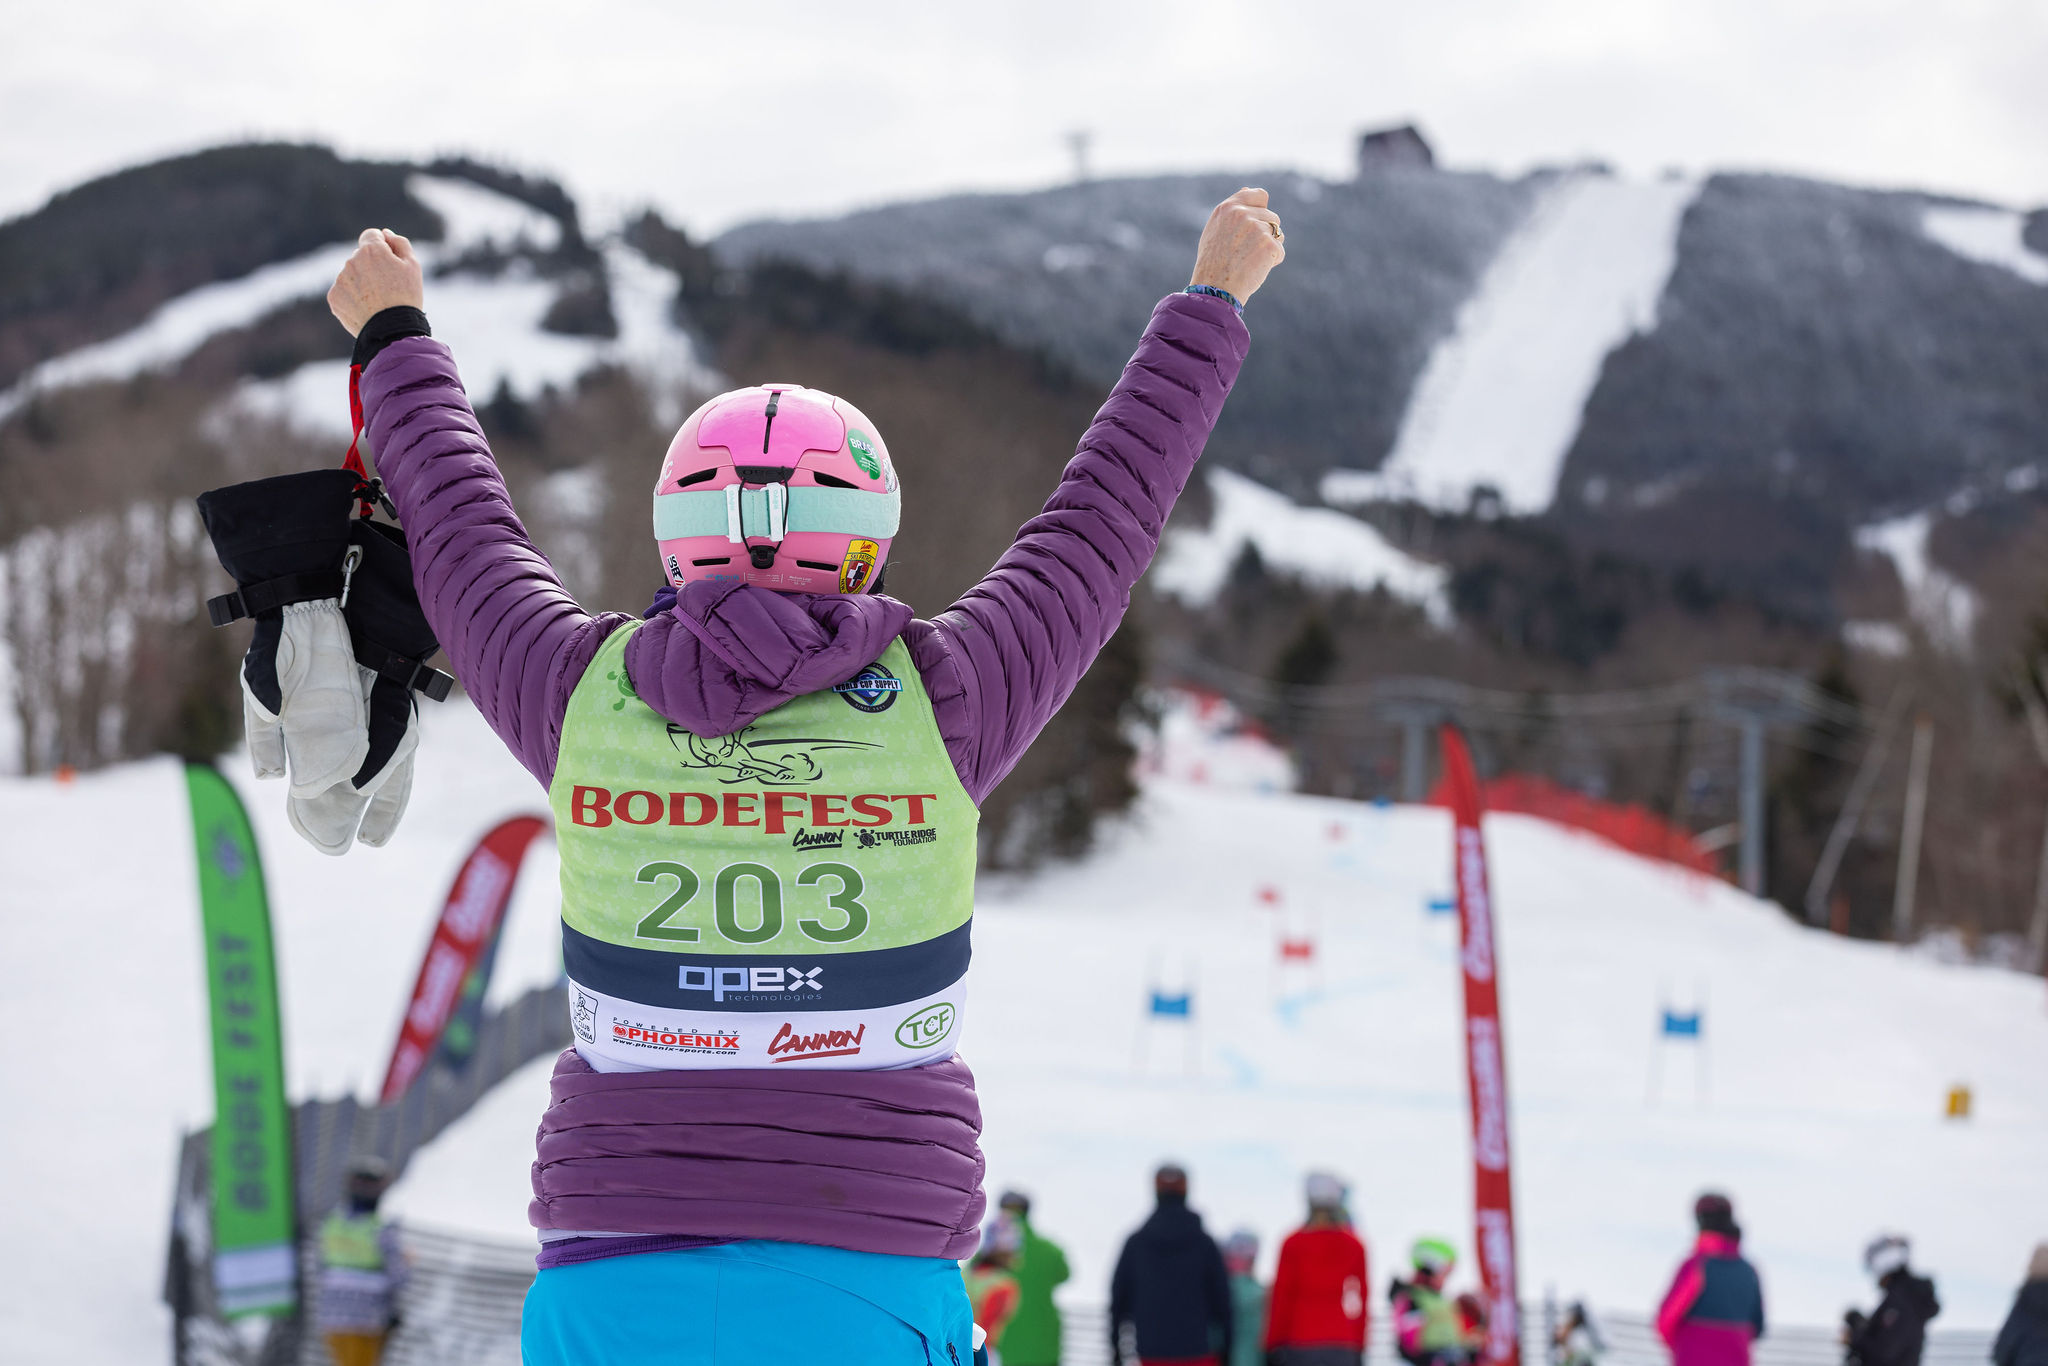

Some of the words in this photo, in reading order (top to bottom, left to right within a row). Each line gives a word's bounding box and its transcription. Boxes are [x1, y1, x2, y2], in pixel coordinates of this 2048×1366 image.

[836, 682, 858, 691] WORLD
[860, 680, 873, 689] CUP
[875, 679, 899, 689] SUPPLY
[875, 830, 911, 841] TURTLE
[911, 828, 936, 839] RIDGE
[893, 835, 937, 847] FOUNDATION
[634, 860, 870, 946] 203
[729, 993, 822, 1002] technologies
[613, 1016, 698, 1034] POWERED
[905, 1008, 949, 1042] TCF
[612, 1037, 737, 1056] www.phoenix-sports.com
[628, 1027, 740, 1049] PHOENIX
